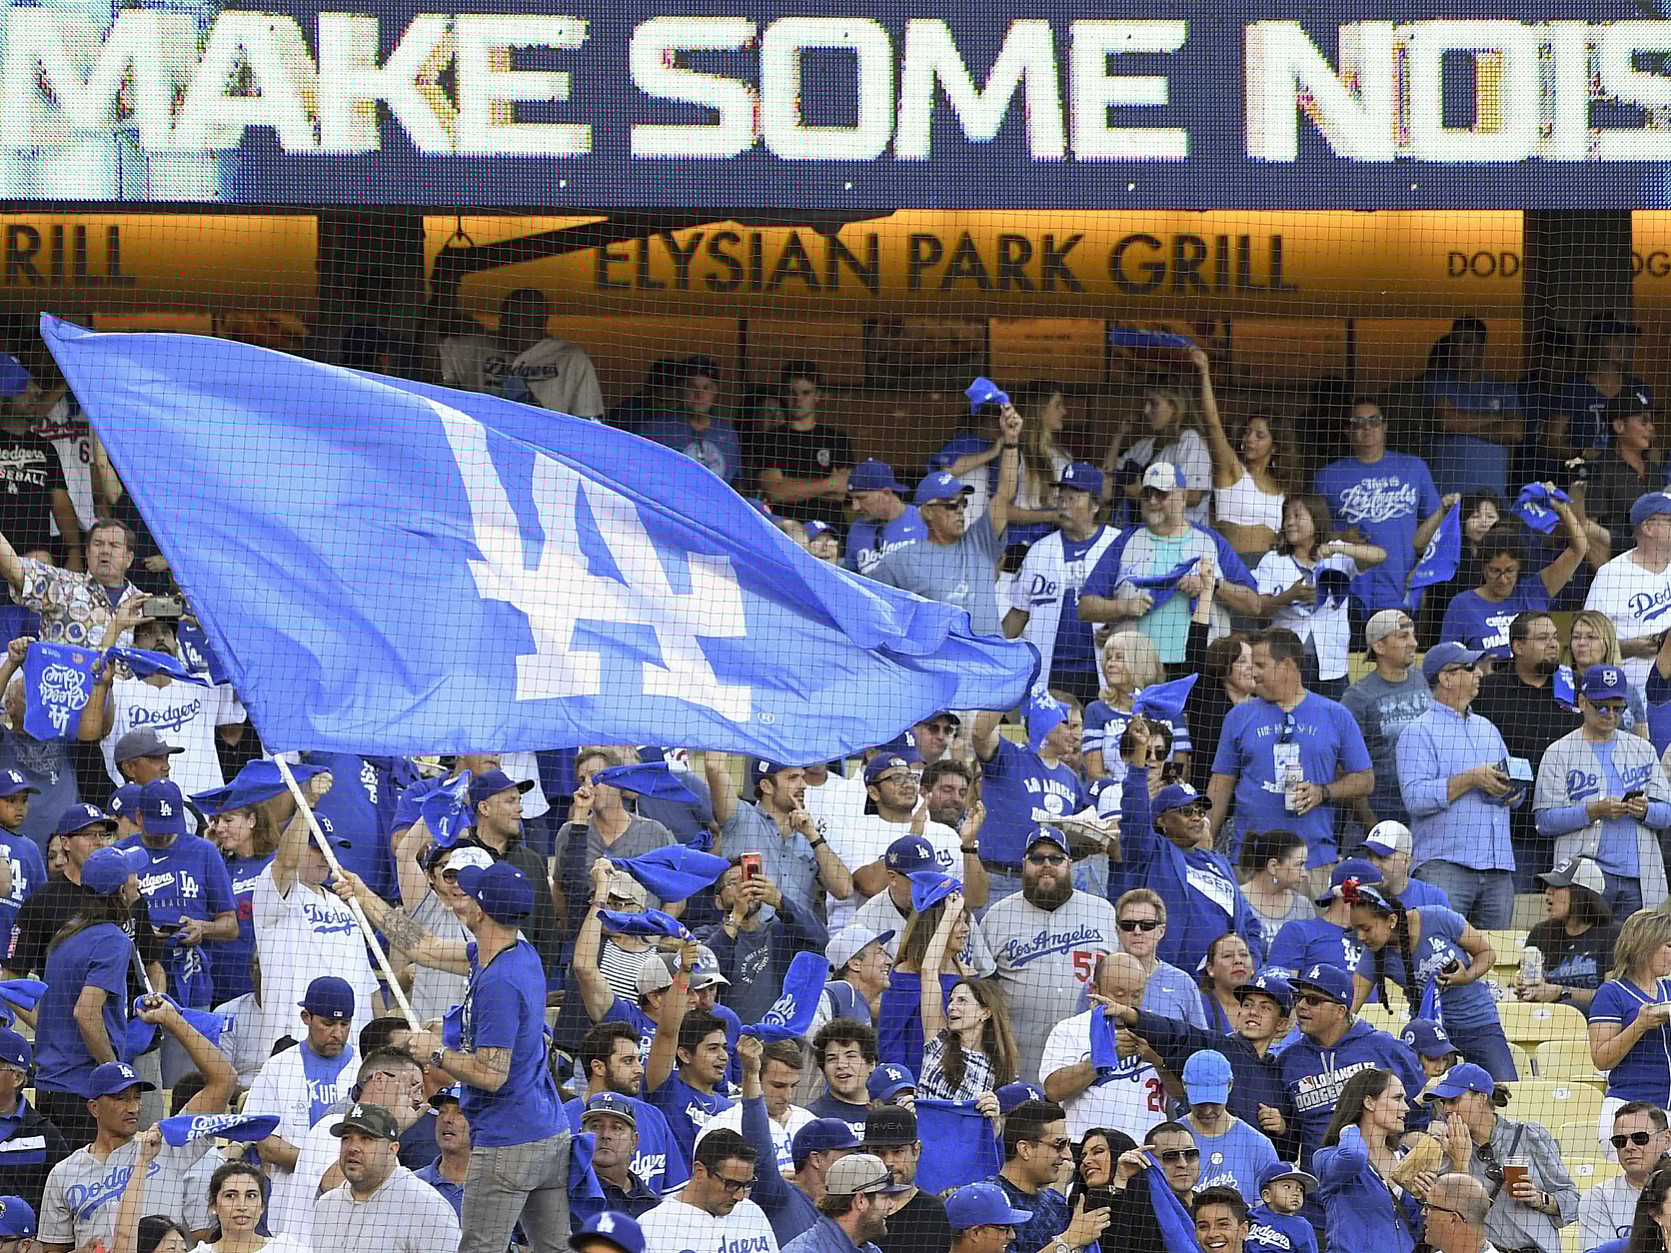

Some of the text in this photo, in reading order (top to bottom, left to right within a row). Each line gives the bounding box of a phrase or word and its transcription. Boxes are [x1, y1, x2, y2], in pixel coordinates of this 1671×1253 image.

[0, 10, 592, 154] MAKE
[630, 17, 1190, 162] SOME
[597, 231, 1298, 294] ELYSIAN PARK GRILL
[0, 445, 47, 469] odgers
[422, 396, 751, 722] LA
[129, 698, 201, 732] Dodgers
[160, 800, 172, 816] LA
[138, 870, 199, 898] odgers LA
[1033, 924, 1103, 955] Angeles
[117, 1064, 134, 1078] LA
[885, 1067, 902, 1081] LA
[1295, 1083, 1345, 1110] DODGER
[66, 1161, 160, 1220] Dodgs
[1192, 1171, 1239, 1192] odgers
